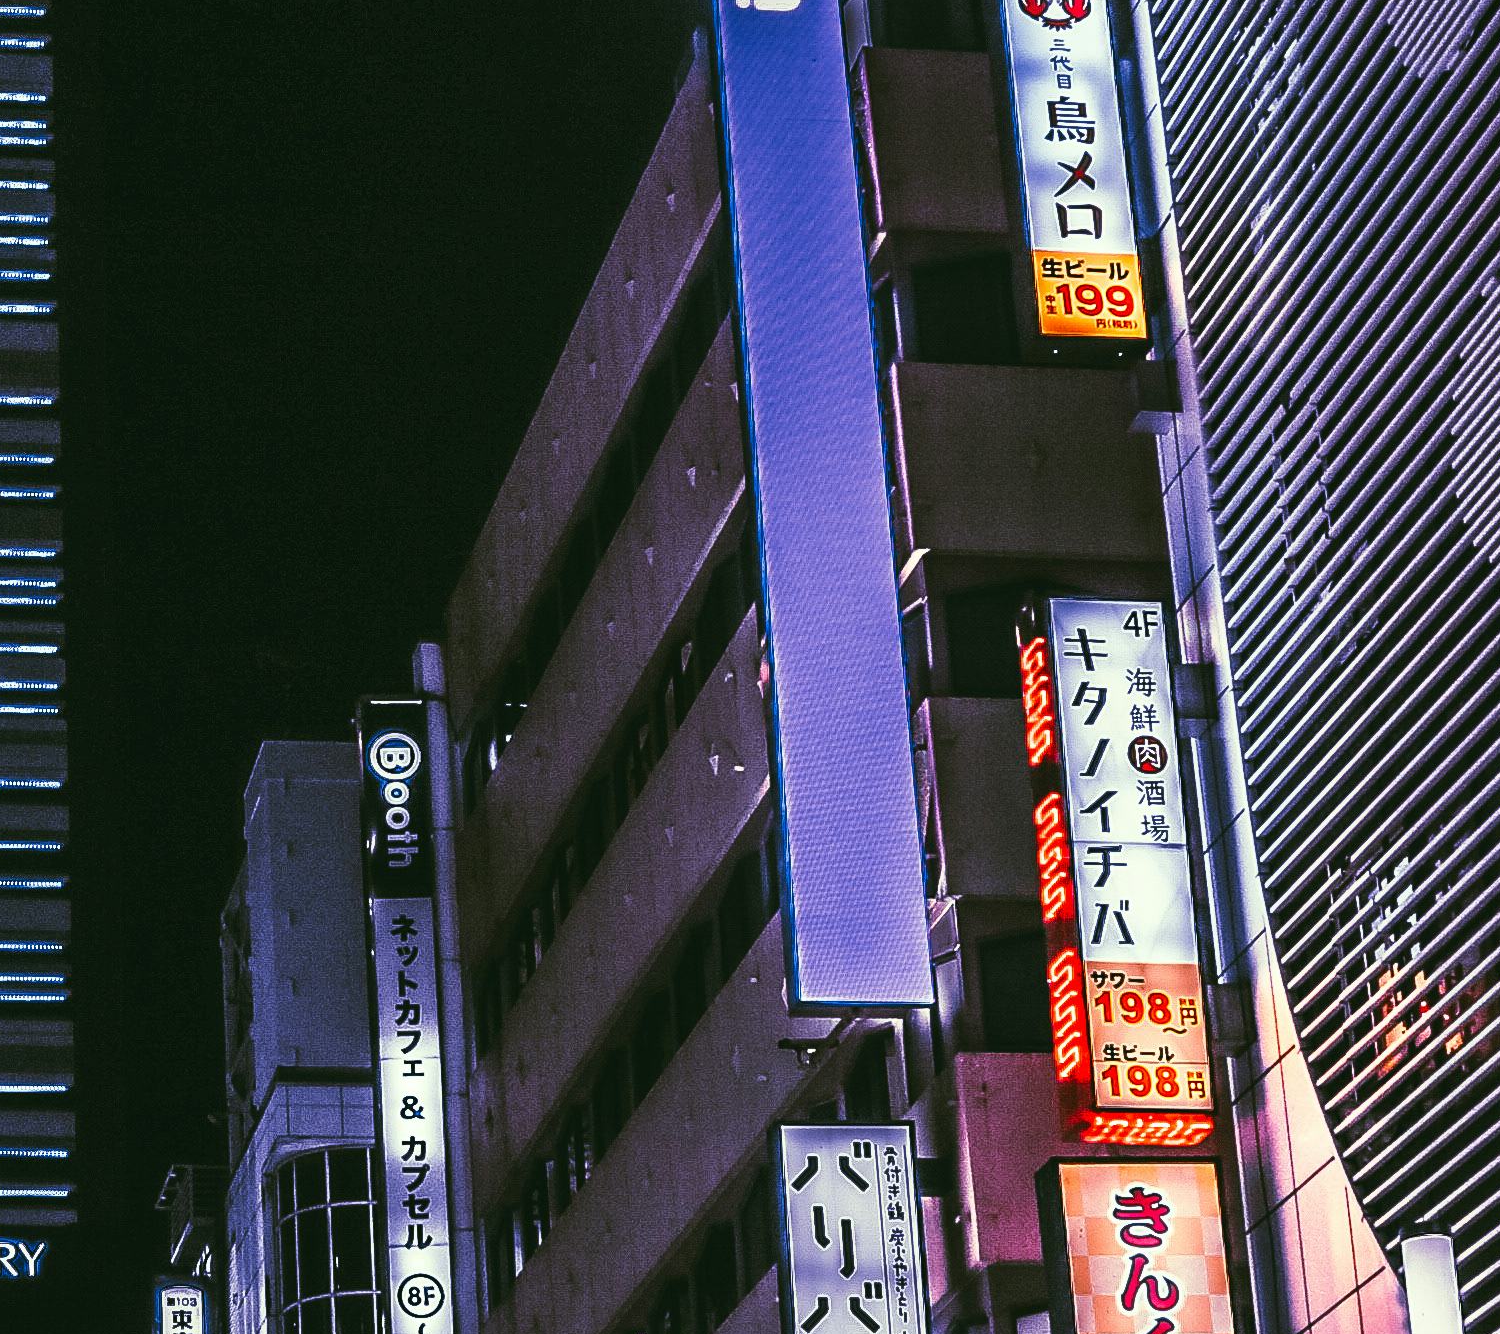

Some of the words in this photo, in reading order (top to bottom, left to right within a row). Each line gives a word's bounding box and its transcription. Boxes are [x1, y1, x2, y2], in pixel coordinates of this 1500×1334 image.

[1048, 37, 1073, 92] 三代目
[1043, 94, 1103, 242] 鳥メロ
[1040, 257, 1131, 282] 生ビール
[1055, 282, 1137, 319] 199
[1122, 609, 1160, 640] 4F
[1124, 667, 1172, 845] 海鮮肉酒場
[368, 732, 422, 868] Booth
[1063, 626, 1136, 947] キタノイチバ
[1089, 970, 1146, 989] サワー
[1102, 1043, 1176, 1064] 生ビール
[390, 913, 434, 1251] ネットカフェ&カプセル
[406, 1285, 436, 1309] 8F
